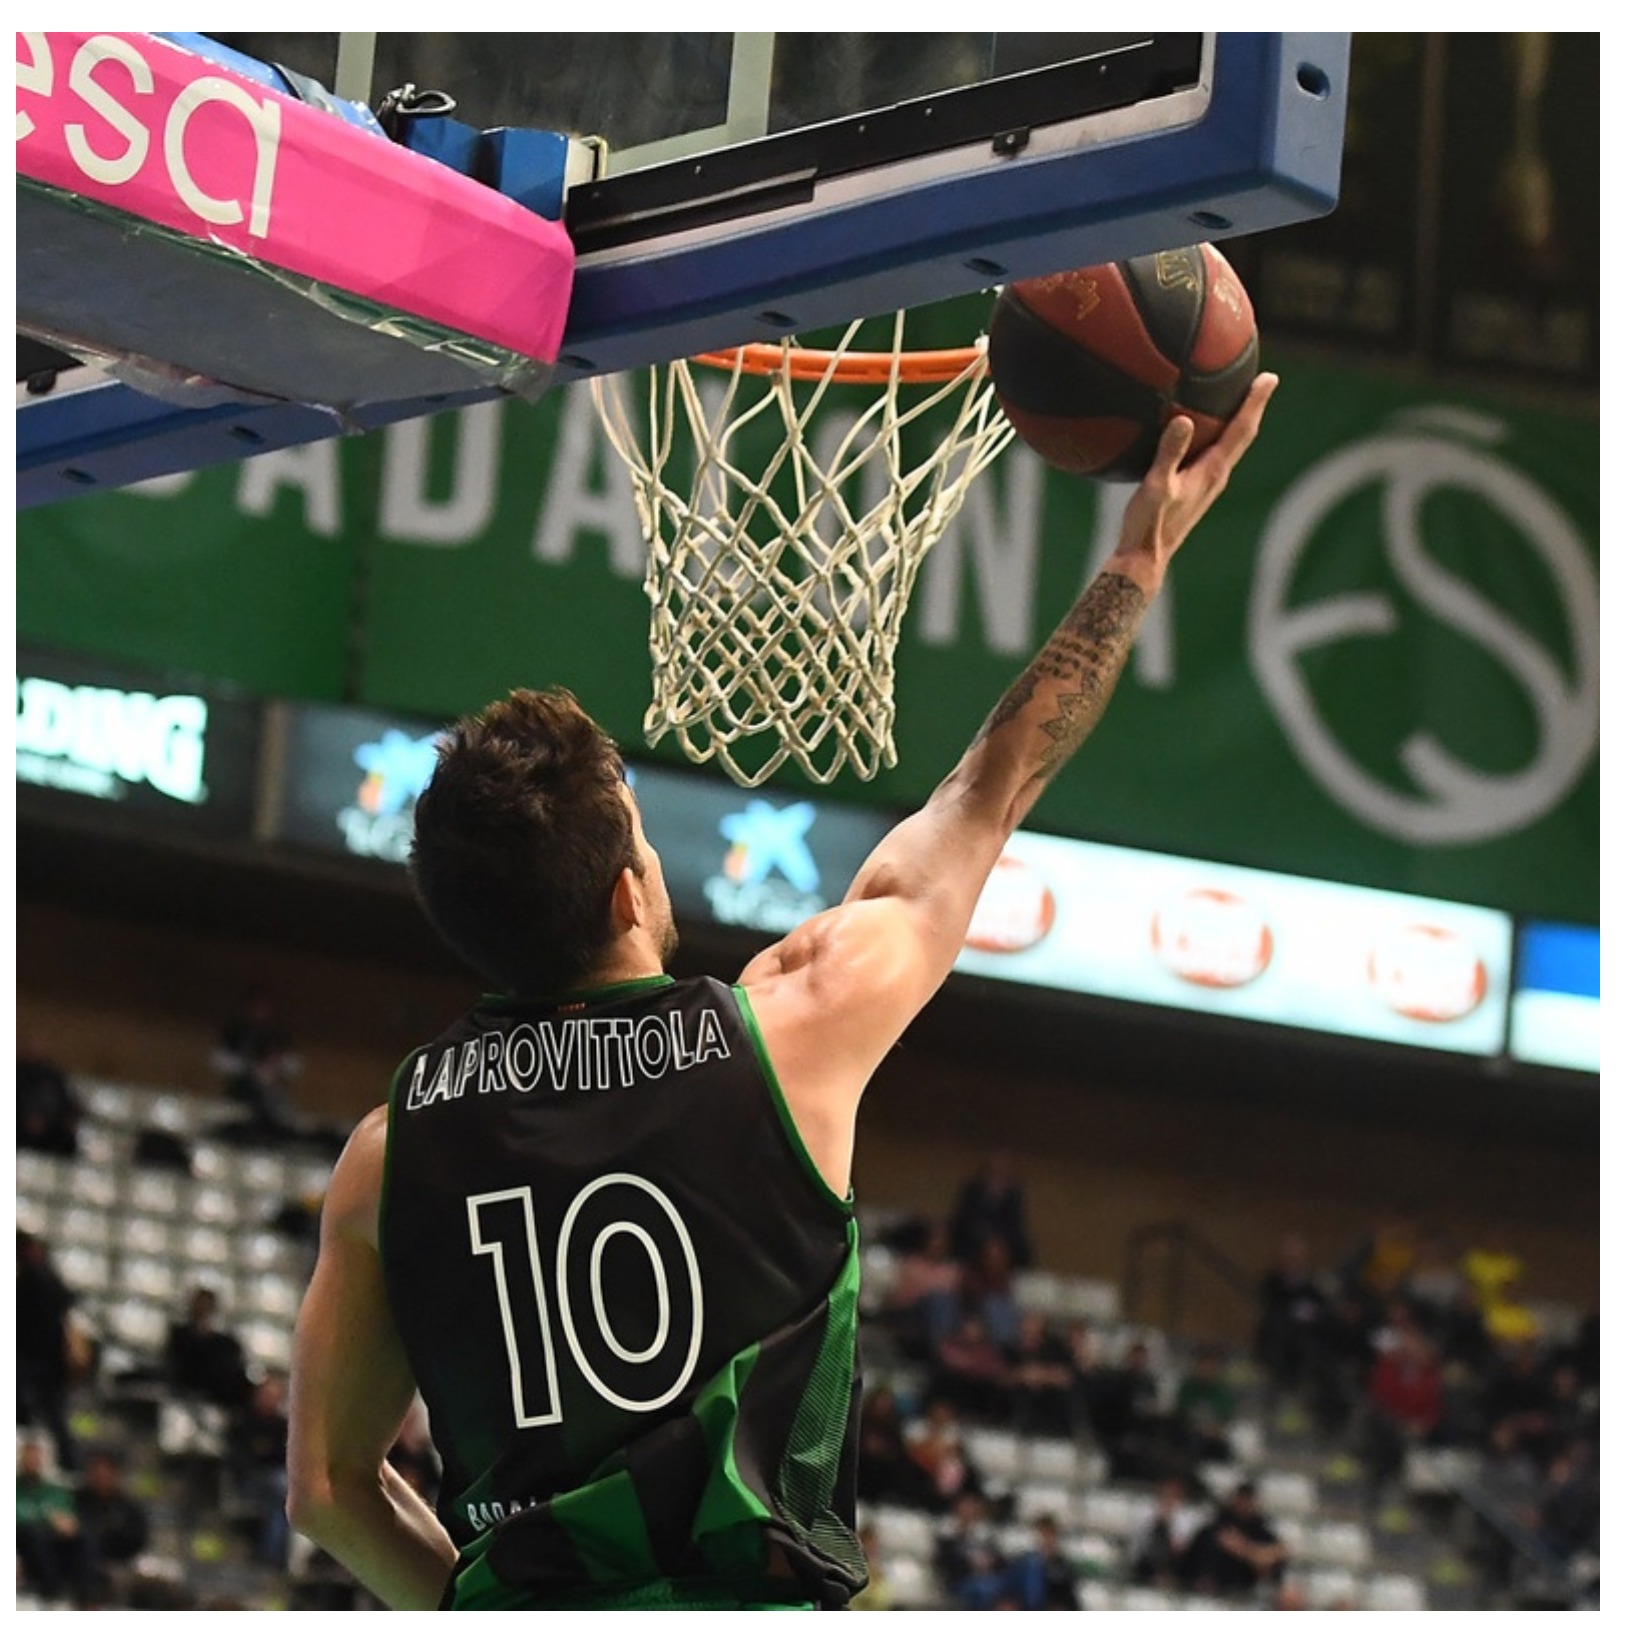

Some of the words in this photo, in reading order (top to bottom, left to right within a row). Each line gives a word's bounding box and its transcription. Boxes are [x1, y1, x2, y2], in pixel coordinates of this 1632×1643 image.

[116, 368, 1180, 690] ADALON
[406, 1009, 731, 1111] LAPROVITTOLA
[466, 1173, 704, 1429] 10
